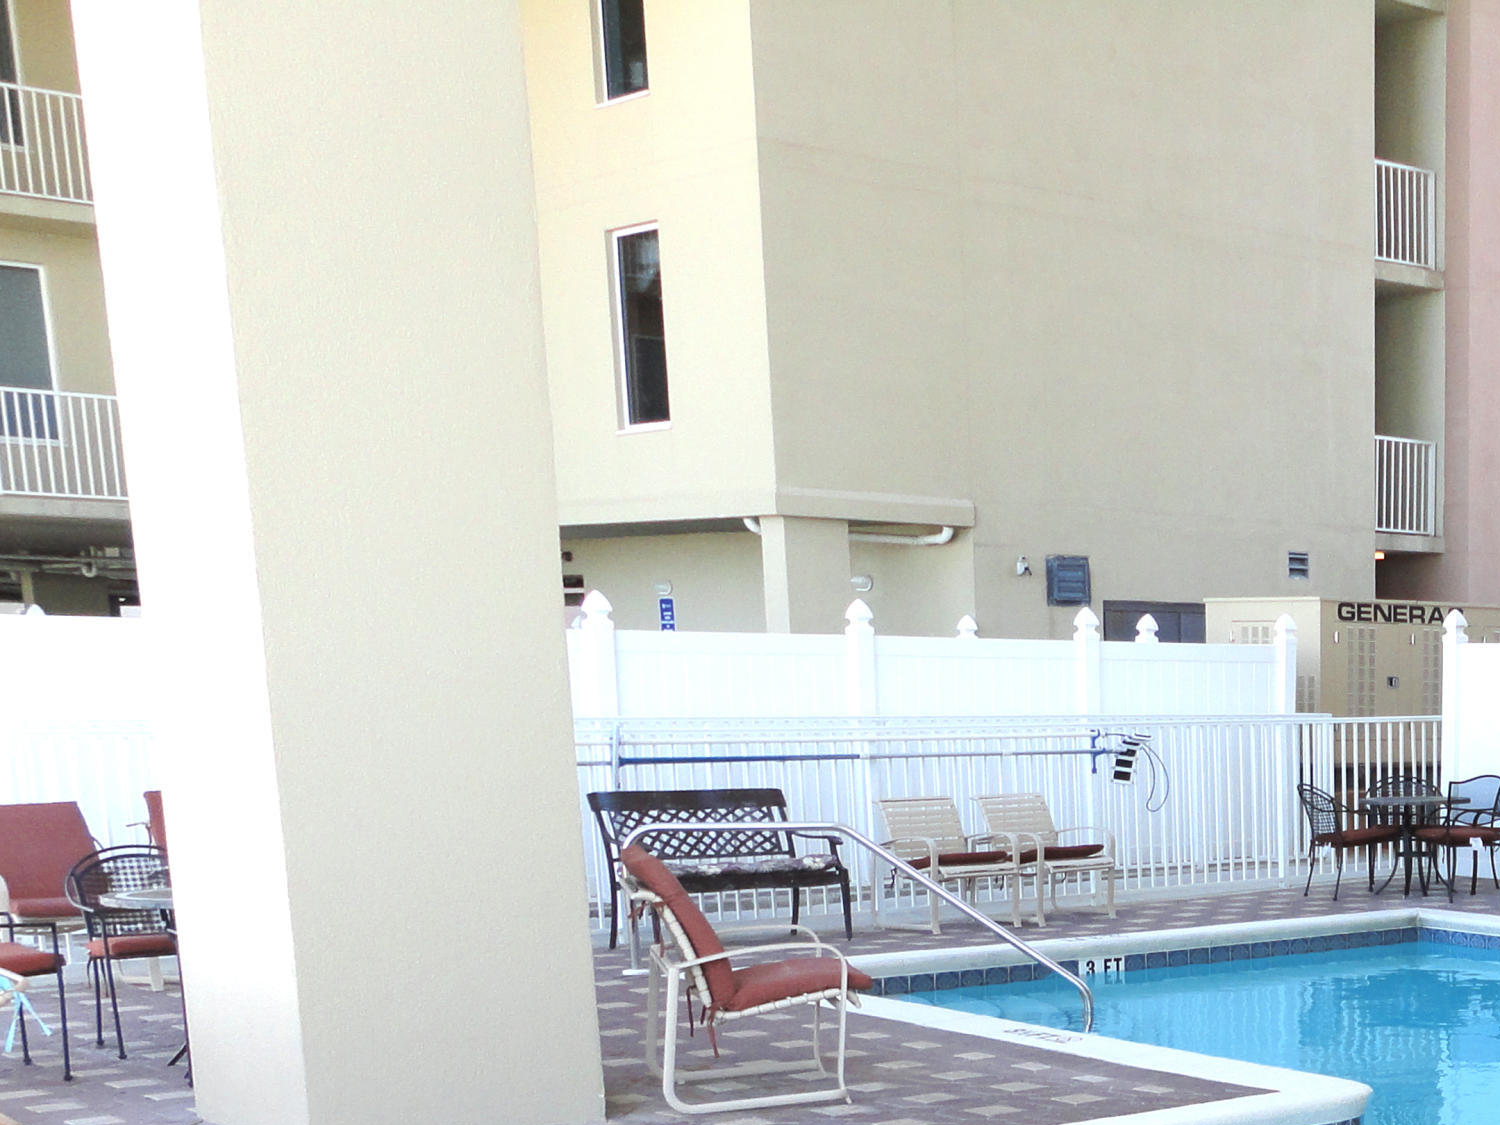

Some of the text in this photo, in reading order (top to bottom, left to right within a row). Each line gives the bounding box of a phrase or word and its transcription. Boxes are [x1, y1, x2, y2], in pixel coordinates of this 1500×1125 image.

[1337, 601, 1464, 625] GENERA
[1086, 957, 1123, 975] 3 FT
